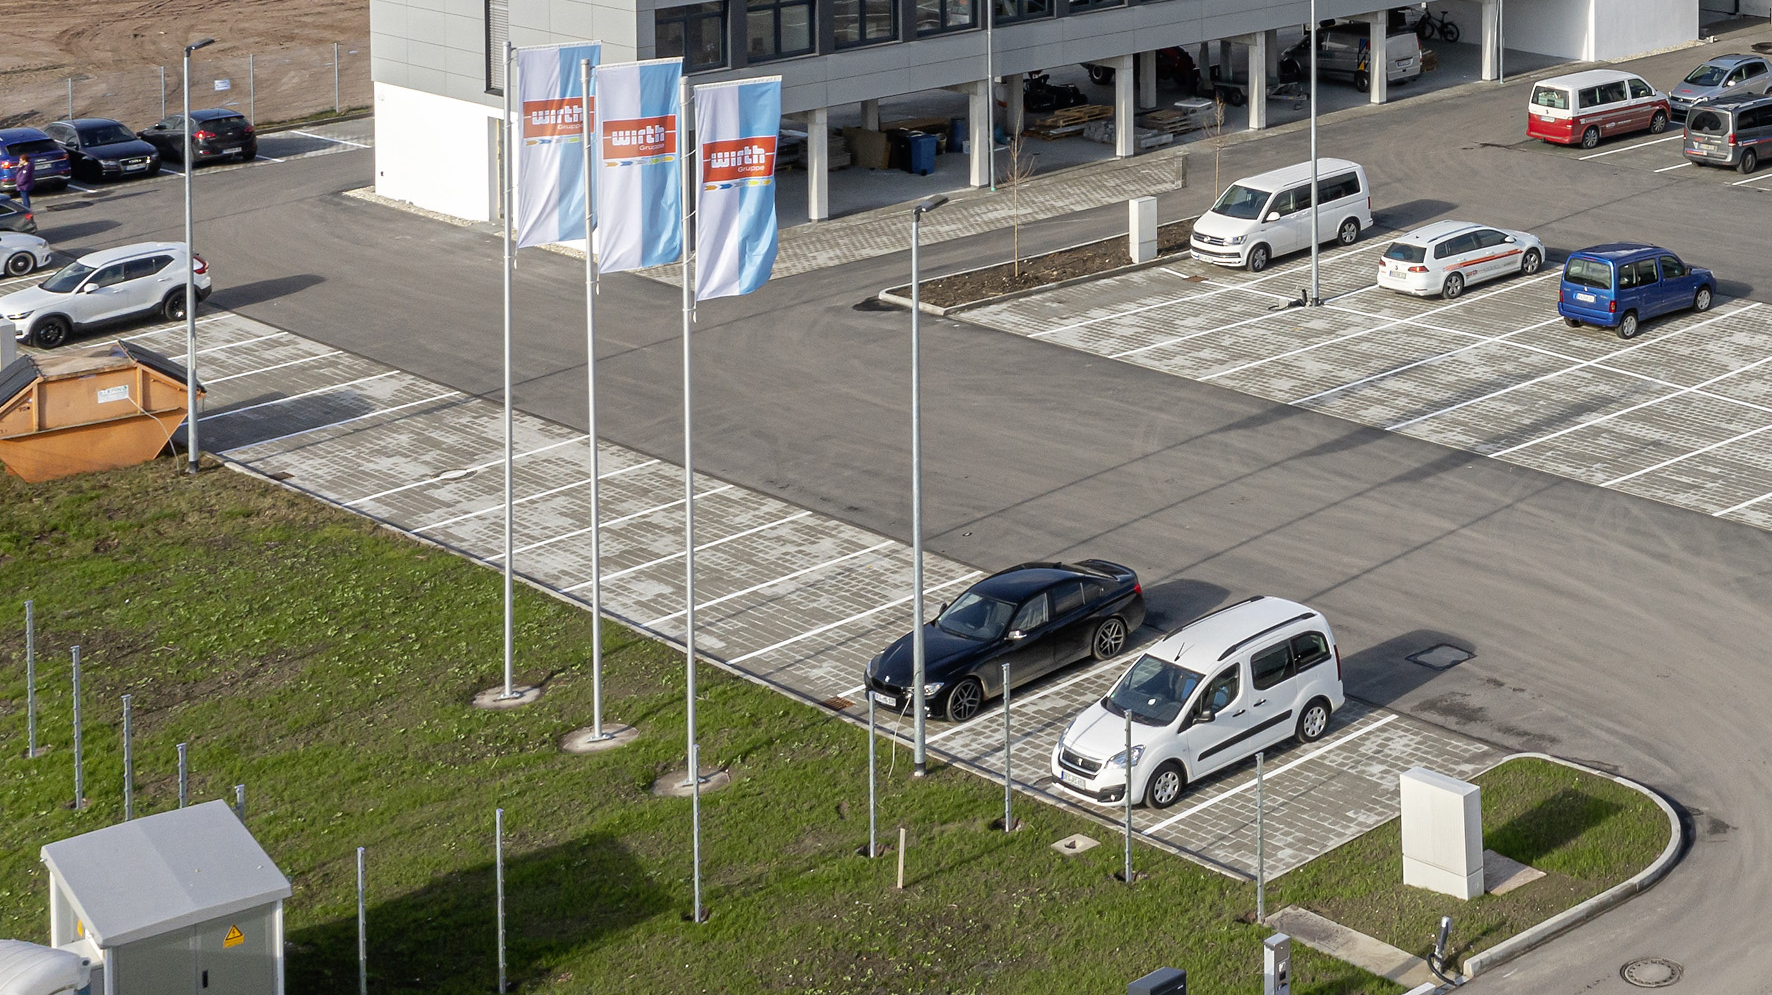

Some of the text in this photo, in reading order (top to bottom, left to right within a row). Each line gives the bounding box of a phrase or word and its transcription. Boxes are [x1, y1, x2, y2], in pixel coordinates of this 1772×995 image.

[557, 123, 583, 131] Grupp
[612, 125, 665, 146] wirth
[639, 143, 665, 151] Gruppe
[711, 145, 766, 169] wirth
[737, 165, 765, 173] Gruppe
